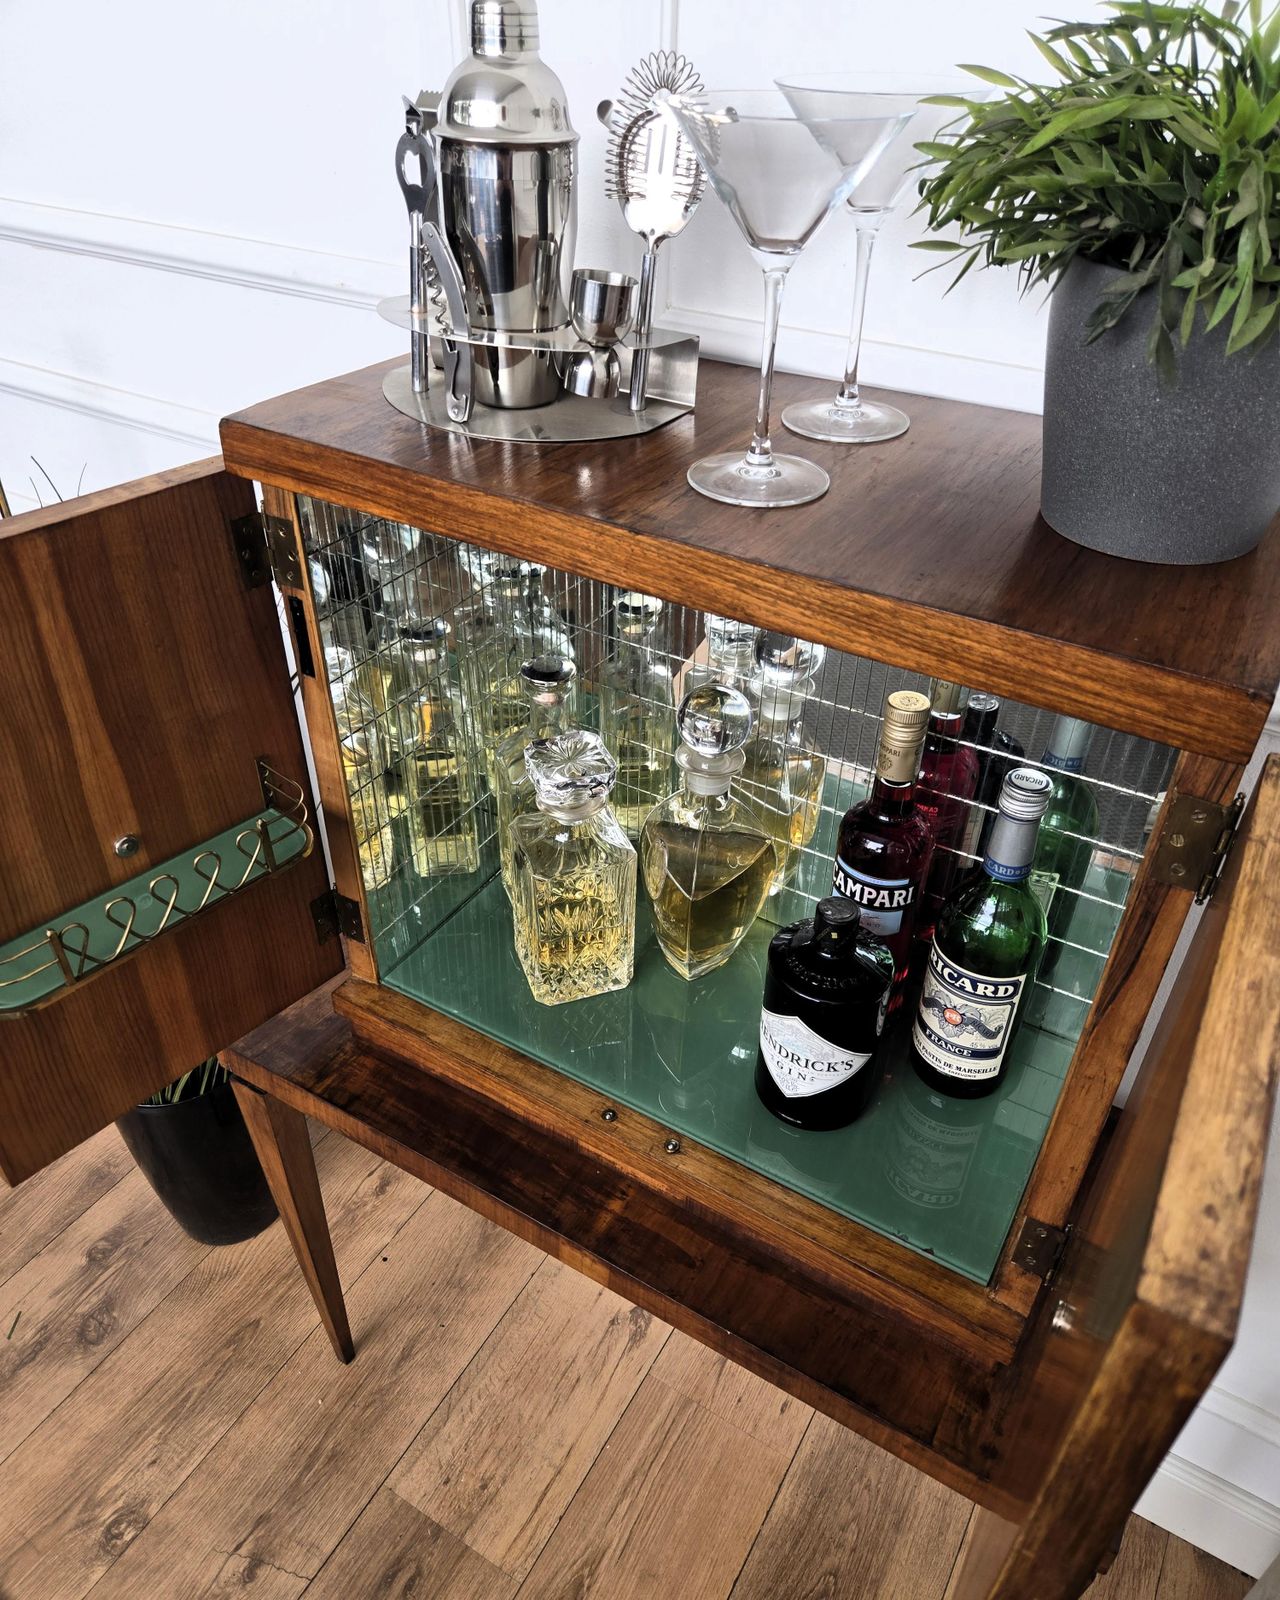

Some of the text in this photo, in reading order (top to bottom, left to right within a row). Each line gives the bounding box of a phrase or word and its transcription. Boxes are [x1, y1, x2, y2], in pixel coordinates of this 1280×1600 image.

[1013, 773, 1044, 786] RICARD
[832, 860, 915, 908] CAMPARI
[930, 948, 1015, 998] RICARD
[926, 1029, 972, 1057] FRANCE
[776, 1060, 808, 1082] GIN
[920, 1045, 998, 1074] PASTIS DE MARSEILLE
